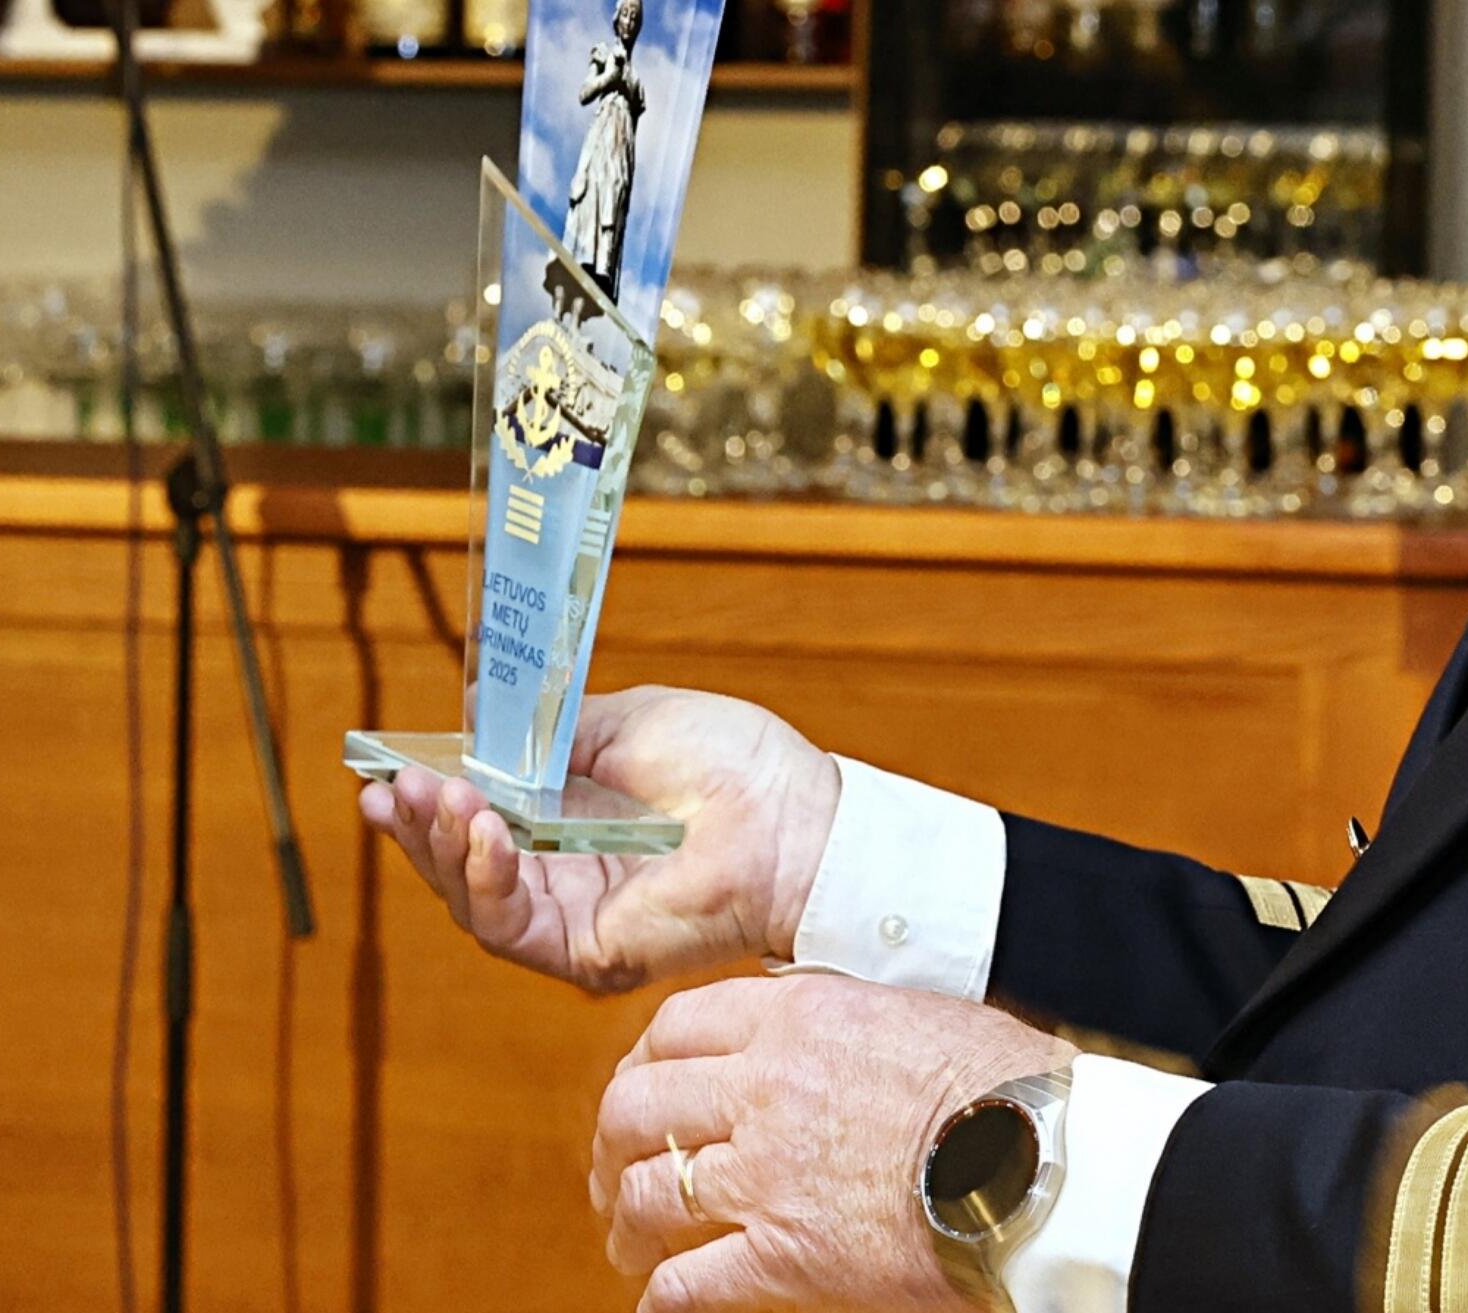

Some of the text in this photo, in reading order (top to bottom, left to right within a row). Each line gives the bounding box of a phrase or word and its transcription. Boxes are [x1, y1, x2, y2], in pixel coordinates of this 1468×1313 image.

[482, 569, 547, 612] LIETUVOS
[491, 601, 529, 638] METŲ
[488, 656, 518, 687] 2025
